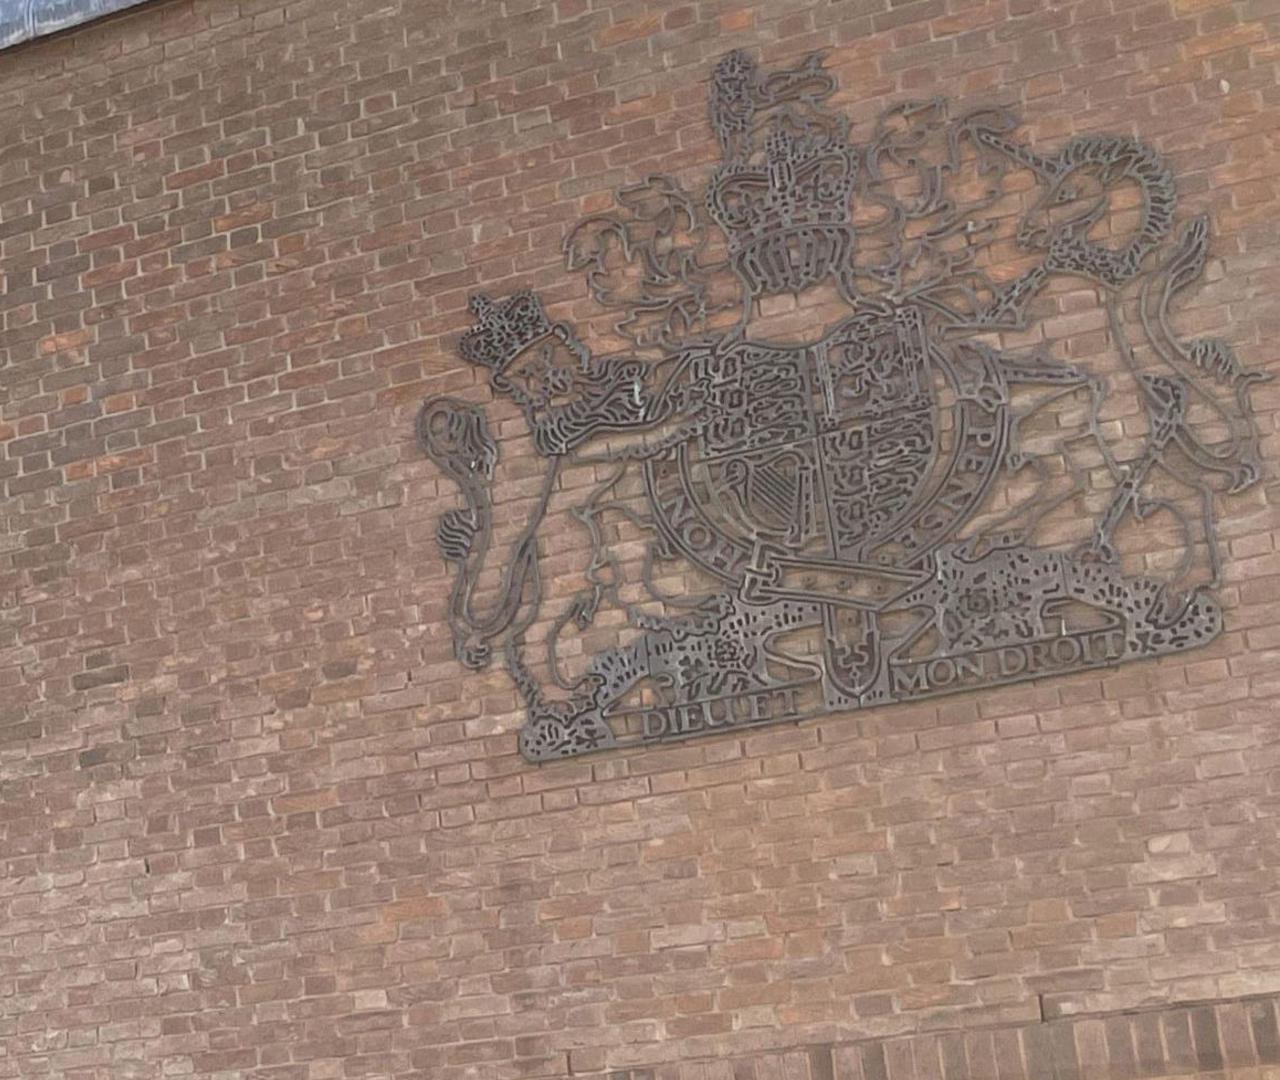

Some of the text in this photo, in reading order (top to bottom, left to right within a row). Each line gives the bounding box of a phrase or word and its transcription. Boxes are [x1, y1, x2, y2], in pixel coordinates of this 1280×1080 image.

[642, 628, 1125, 739] DIEU ET MON DROIT
